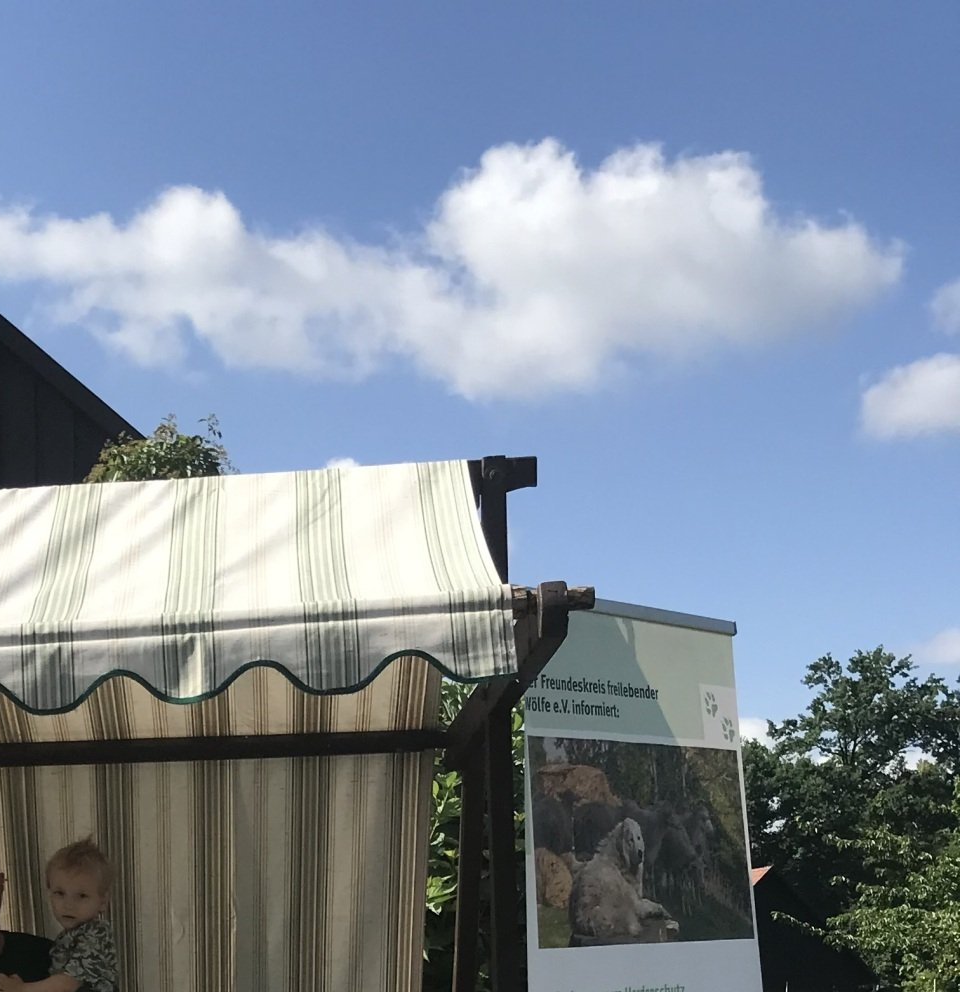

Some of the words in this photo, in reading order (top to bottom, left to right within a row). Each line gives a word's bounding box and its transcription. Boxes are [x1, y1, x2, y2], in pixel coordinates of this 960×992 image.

[541, 674, 606, 694] Freundeskreis
[607, 680, 658, 700] freilebender
[553, 699, 570, 714] e.V.
[572, 700, 620, 718] informiert:
